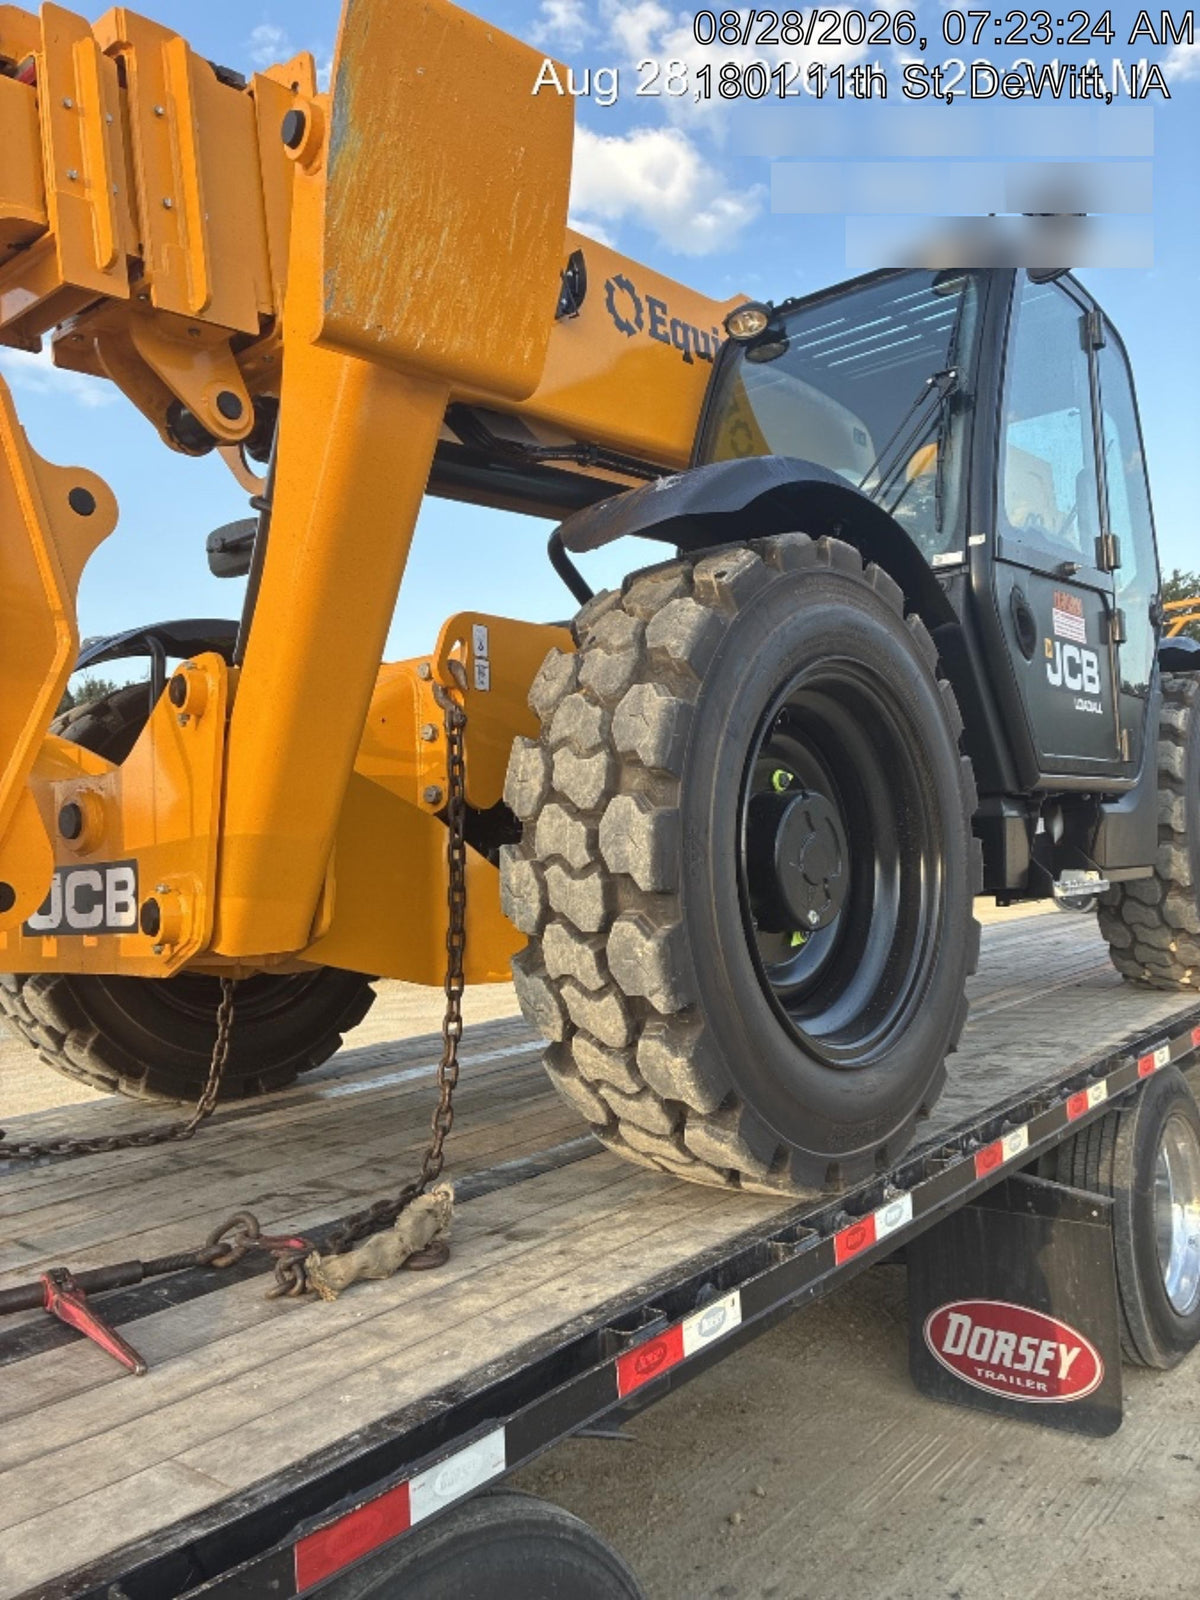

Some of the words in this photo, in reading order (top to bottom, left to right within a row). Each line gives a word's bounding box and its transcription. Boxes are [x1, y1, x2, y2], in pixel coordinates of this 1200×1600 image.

[1046, 641, 1100, 694] JCB
[28, 867, 137, 930] JCB
[974, 1366, 1049, 1393] TRAILER
